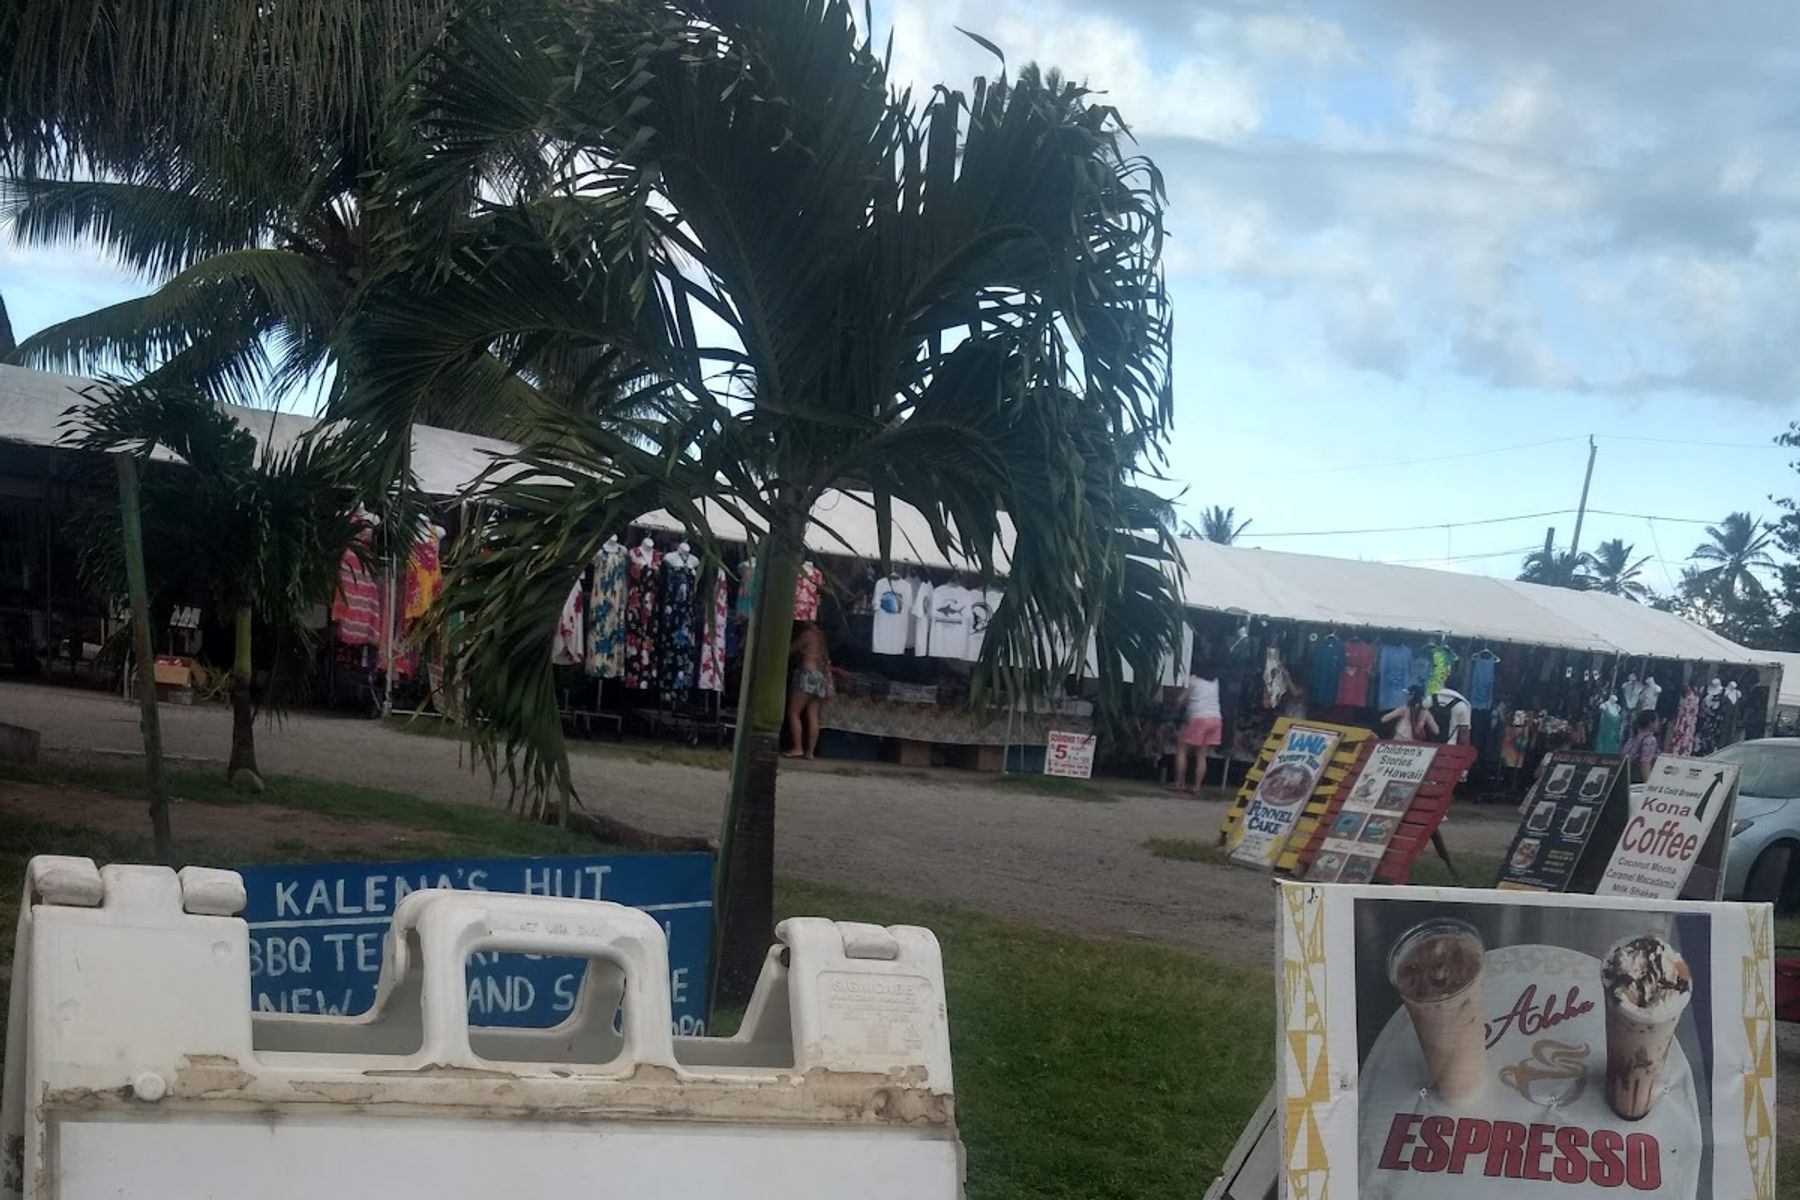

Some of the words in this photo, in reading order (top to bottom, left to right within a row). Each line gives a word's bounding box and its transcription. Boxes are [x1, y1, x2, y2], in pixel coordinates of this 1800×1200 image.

[1379, 755, 1413, 767] Stories
[1383, 768, 1422, 780] Hawaii
[1641, 797, 1691, 817] Kona
[1622, 816, 1698, 860] Coffee
[1618, 857, 1650, 868] Coconut
[1650, 862, 1676, 874] Mocha
[525, 865, 612, 900] HUT
[1629, 887, 1659, 899] Shakes
[1377, 1113, 1662, 1190] ESPRESSO
